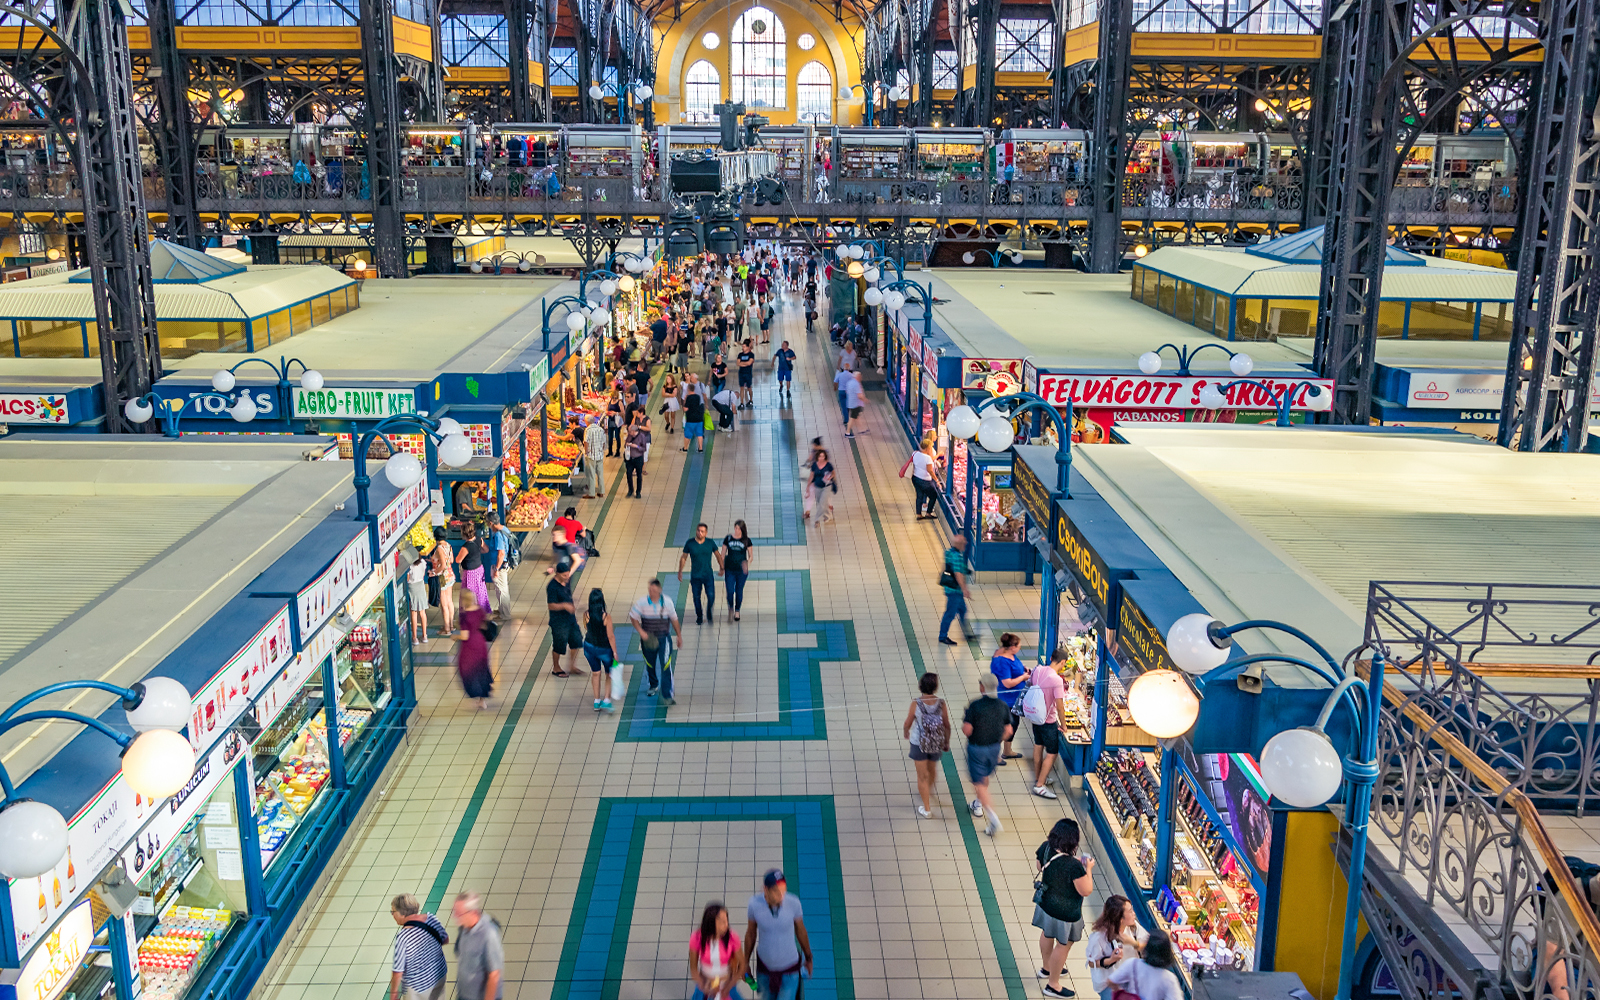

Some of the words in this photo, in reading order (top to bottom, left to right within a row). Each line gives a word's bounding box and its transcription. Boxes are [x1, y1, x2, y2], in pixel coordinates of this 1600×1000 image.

[298, 391, 384, 415] AGRO-FRUIT
[387, 393, 416, 415] KFT.
[1042, 377, 1183, 405] FELVÁGOTT
[1113, 411, 1180, 422] KABANOS
[1120, 605, 1154, 663] Chocolate
[177, 760, 210, 802] UNICUM
[93, 799, 118, 834] TOKAJI
[33, 936, 80, 1000] TOKAJI
